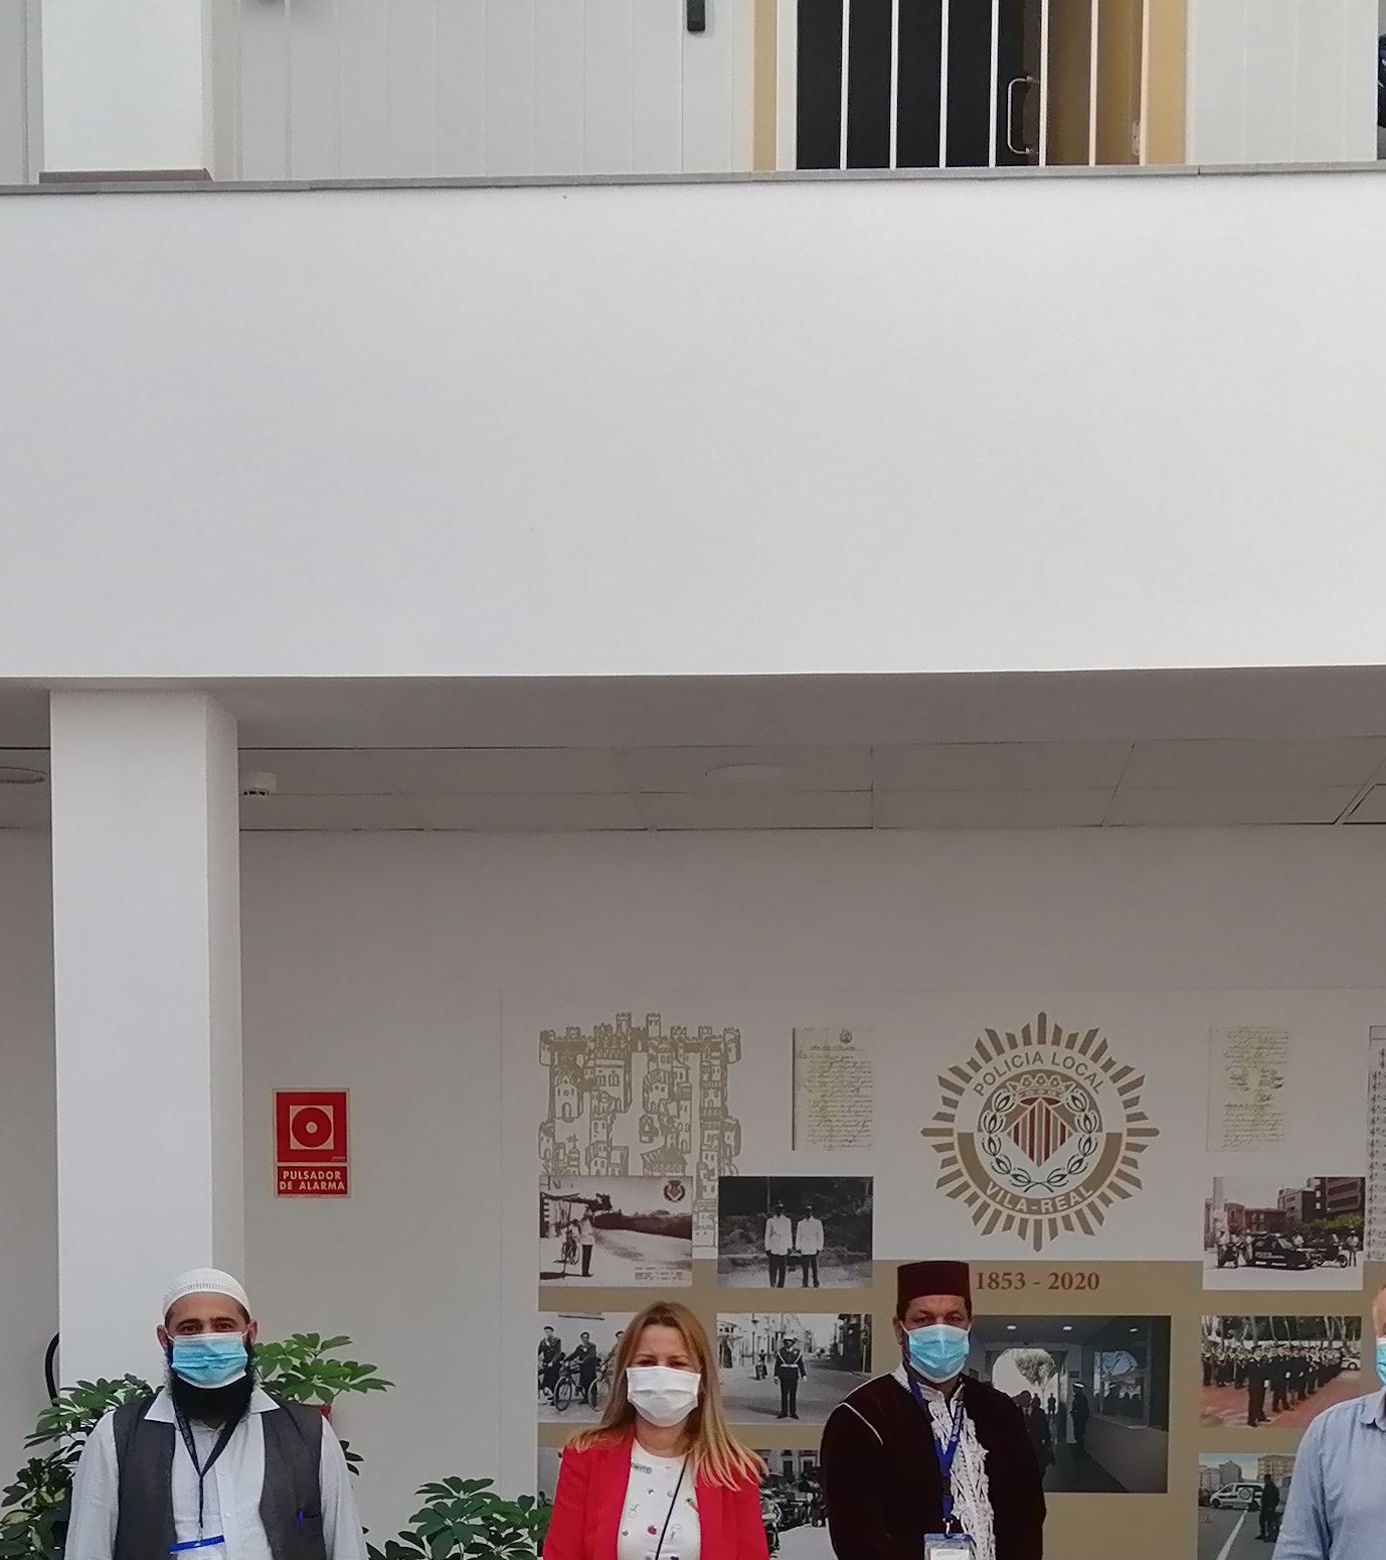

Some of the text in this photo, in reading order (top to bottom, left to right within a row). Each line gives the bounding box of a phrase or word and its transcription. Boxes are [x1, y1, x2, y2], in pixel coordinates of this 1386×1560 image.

[972, 1051, 1107, 1097] POLICIA LOCAL
[283, 1170, 341, 1180] PULSADOR
[279, 1181, 345, 1191] DE ALARMA
[984, 1180, 1093, 1214] VILA-REAL
[976, 1271, 1026, 1290] 1853
[1047, 1271, 1100, 1290] 2020
